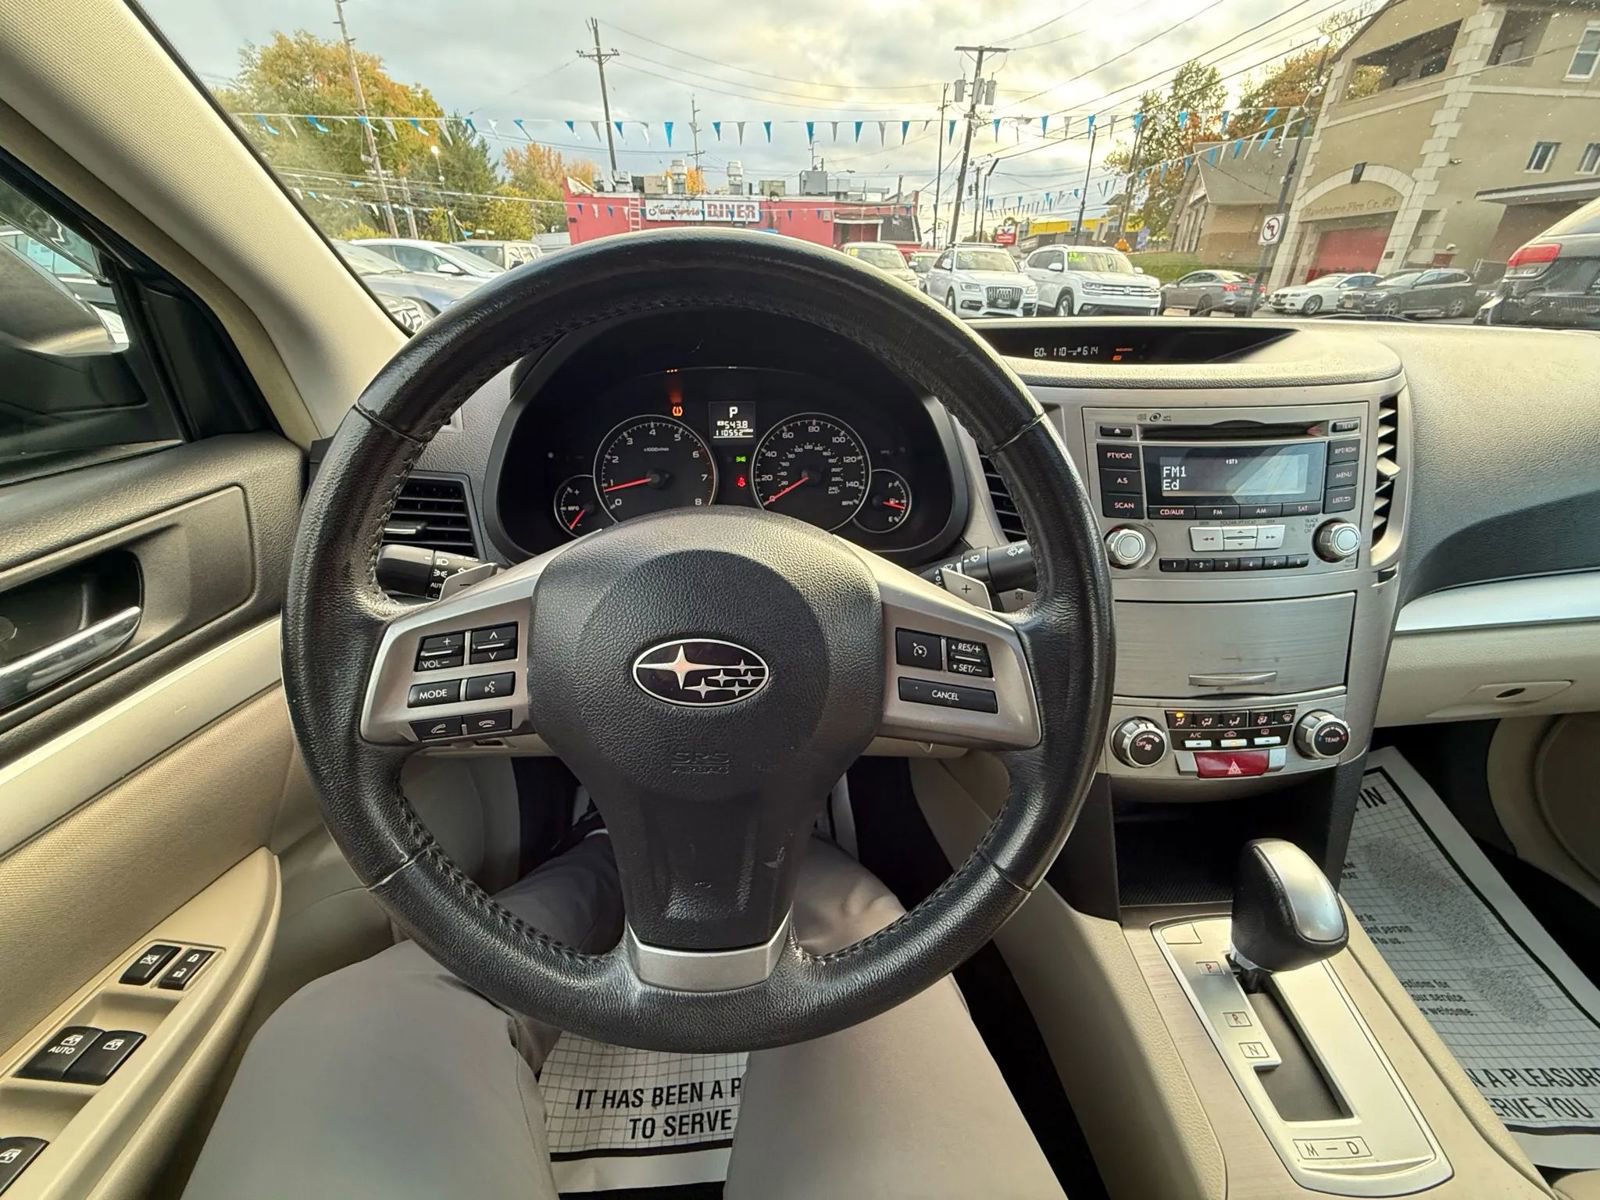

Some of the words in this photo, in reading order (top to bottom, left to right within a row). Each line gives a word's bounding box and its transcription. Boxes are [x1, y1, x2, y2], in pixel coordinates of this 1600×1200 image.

[707, 204, 756, 219] DINER
[729, 406, 738, 418] P
[808, 425, 820, 433] 80
[626, 437, 634, 445] 3
[674, 434, 682, 442] 5
[612, 455, 620, 464] 2
[692, 451, 700, 459] 6
[1106, 452, 1133, 460] PTY/CAT
[1163, 466, 1187, 478] FM1
[1335, 471, 1353, 479] MENU
[701, 474, 708, 482] 7
[1163, 479, 1180, 491] Ed
[614, 498, 623, 506] 0
[694, 498, 702, 506] 8
[1159, 508, 1185, 516] CD/AUX
[421, 660, 441, 668] VOL
[419, 688, 448, 700] MODE
[931, 689, 960, 701] CANCEL
[1205, 963, 1213, 973] P
[1231, 1014, 1242, 1025] R
[48, 1046, 76, 1055] AUTO
[1248, 1045, 1260, 1056] N
[1481, 1067, 1507, 1088] A
[575, 1089, 598, 1110] IT
[601, 1088, 644, 1109] HAS
[651, 1082, 703, 1107] BEEN
[710, 1080, 723, 1100] A
[1535, 1097, 1595, 1119] YOU
[629, 1117, 656, 1140] TO
[663, 1108, 732, 1137] SERVE
[1305, 1144, 1320, 1156] M
[1346, 1141, 1360, 1155] D
